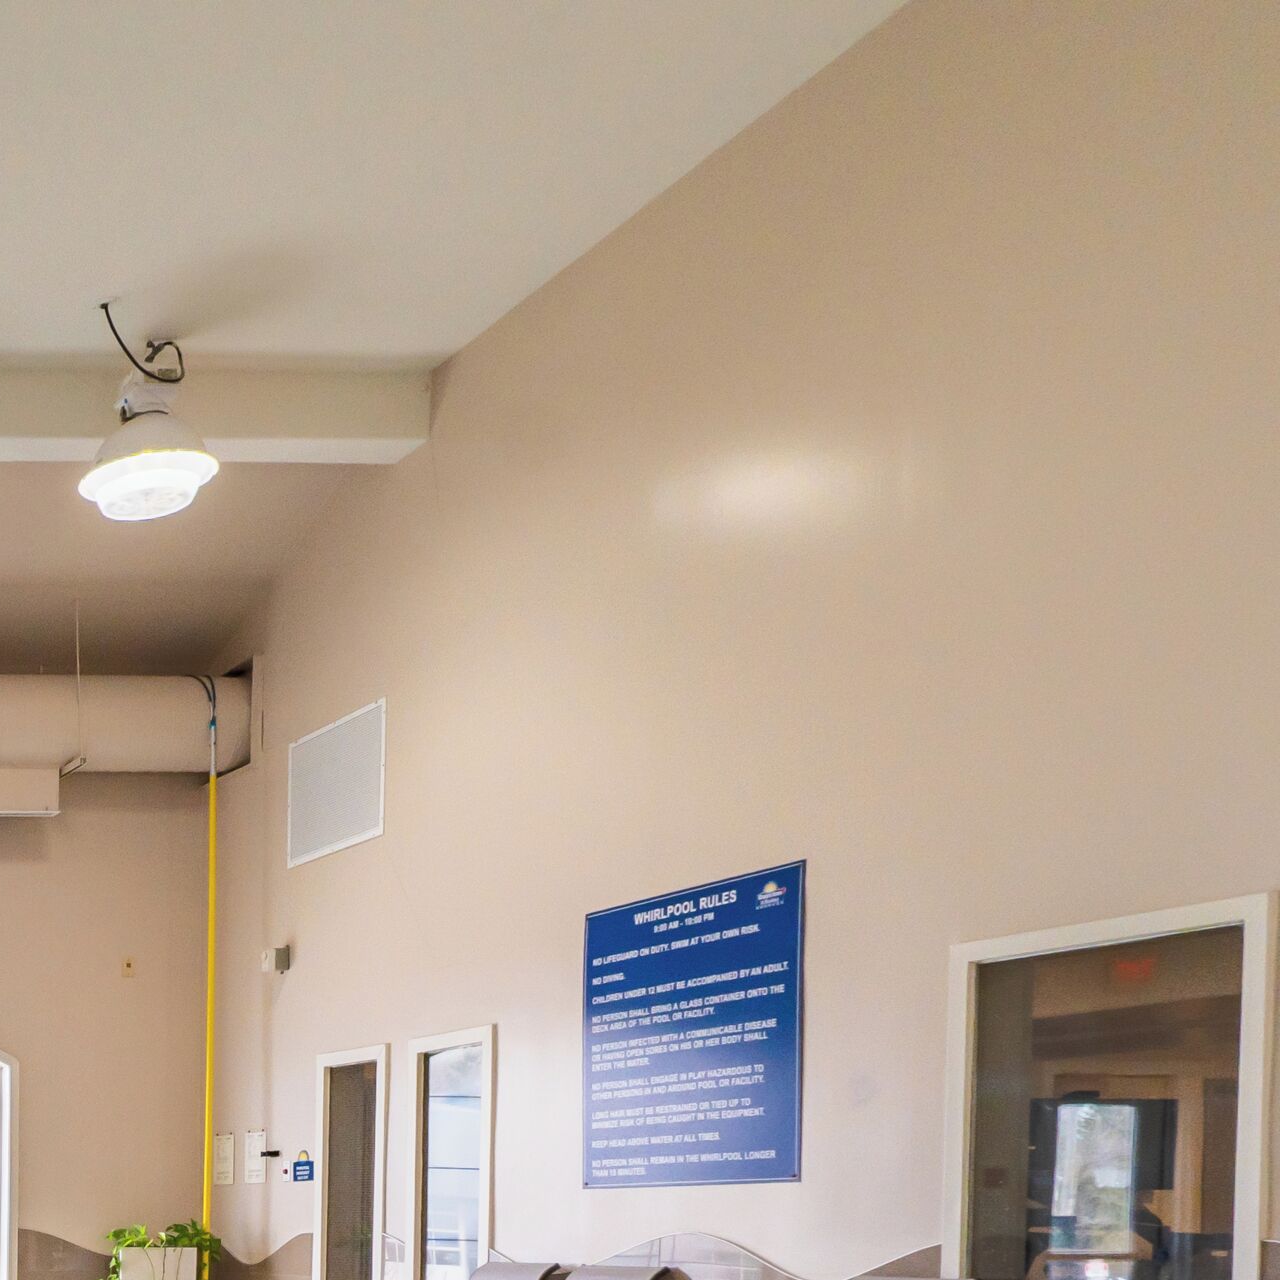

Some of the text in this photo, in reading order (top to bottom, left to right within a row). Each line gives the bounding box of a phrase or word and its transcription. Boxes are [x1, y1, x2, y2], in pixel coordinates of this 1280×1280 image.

[634, 900, 697, 925] WHIRLPOOL
[700, 890, 737, 910] RULES
[703, 912, 714, 921] PM
[593, 958, 602, 966] NO
[603, 950, 639, 964] LIFEGUARD
[640, 947, 649, 956] ON
[651, 943, 670, 954] DUTY.
[690, 936, 699, 946] AT
[701, 932, 720, 943] YOUR
[722, 928, 739, 939] OWN
[741, 923, 760, 935] RISK.
[592, 972, 626, 985] NO DIVING.
[592, 961, 789, 1004] CHILDREN UNDER 12 MUST BE ACCOMPANIED BY AN ADULT.
[592, 1015, 601, 1024] NO
[602, 1011, 628, 1022] PERSON
[629, 1007, 650, 1018] SHALL
[673, 1002, 678, 1010] A
[680, 998, 703, 1009] GLASS
[704, 991, 745, 1005] CONTAINER
[747, 987, 768, 998] ONTO
[770, 984, 785, 994] THE
[592, 1007, 716, 1033] DECK AREA OF THE POOL OR FACILITY.
[592, 1018, 777, 1052] NO PERSON INFECTED WITH A COMMUNICABLE DISEASE
[626, 1048, 644, 1057] OPEN
[645, 1045, 667, 1055] SORES
[669, 1043, 679, 1052] ON
[680, 1041, 692, 1050] HIS
[693, 1040, 704, 1048] OR
[705, 1037, 720, 1047] HER
[721, 1034, 742, 1044] BODY
[744, 1031, 768, 1041] SHALL
[592, 1062, 612, 1071] ENTER
[602, 1080, 627, 1090] PERSON
[651, 1074, 679, 1084] ENGAGE
[688, 1071, 705, 1080] PLAY
[707, 1065, 752, 1078] HAZARDOUS
[754, 1064, 764, 1072] TO
[652, 1085, 667, 1094] AND
[698, 1080, 718, 1089] POOL
[719, 1078, 730, 1087] OR
[731, 1074, 766, 1086] FACILITY.
[699, 1101, 710, 1110] OR
[710, 1100, 728, 1109] TIED
[728, 1099, 739, 1107] UP
[740, 1097, 751, 1106] TO
[635, 1118, 645, 1126] OF
[706, 1111, 720, 1120] THE
[683, 1134, 697, 1142] ALL
[701, 1152, 743, 1162] WHIRLPOOL
[744, 1150, 776, 1159] LONGER
